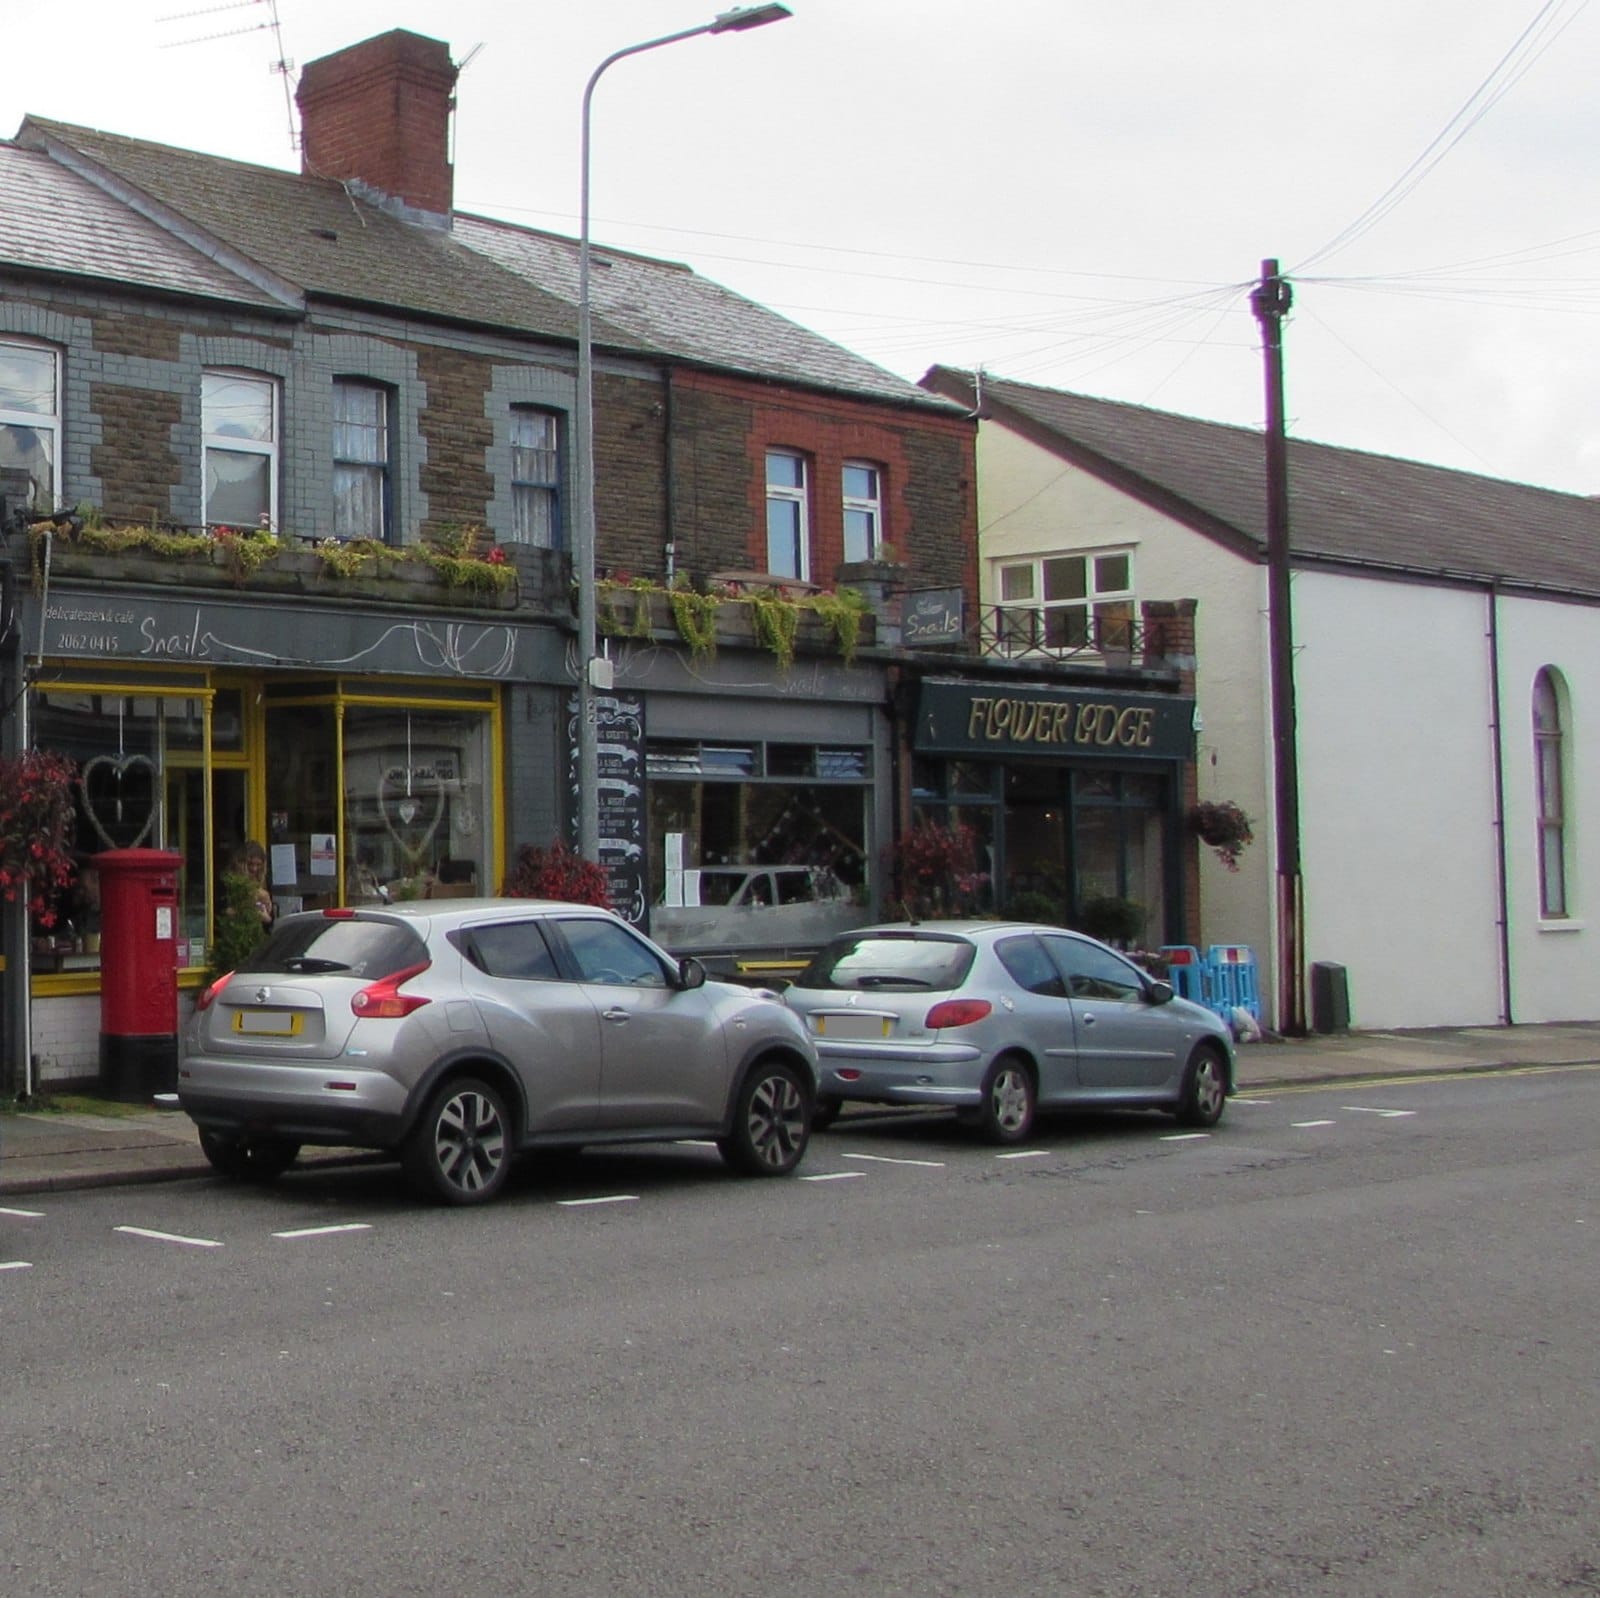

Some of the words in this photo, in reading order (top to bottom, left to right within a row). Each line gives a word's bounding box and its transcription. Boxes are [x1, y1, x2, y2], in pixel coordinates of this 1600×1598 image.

[139, 607, 212, 657] Snails
[968, 697, 1070, 743] FLOWER
[1073, 702, 1155, 747] LODGE
